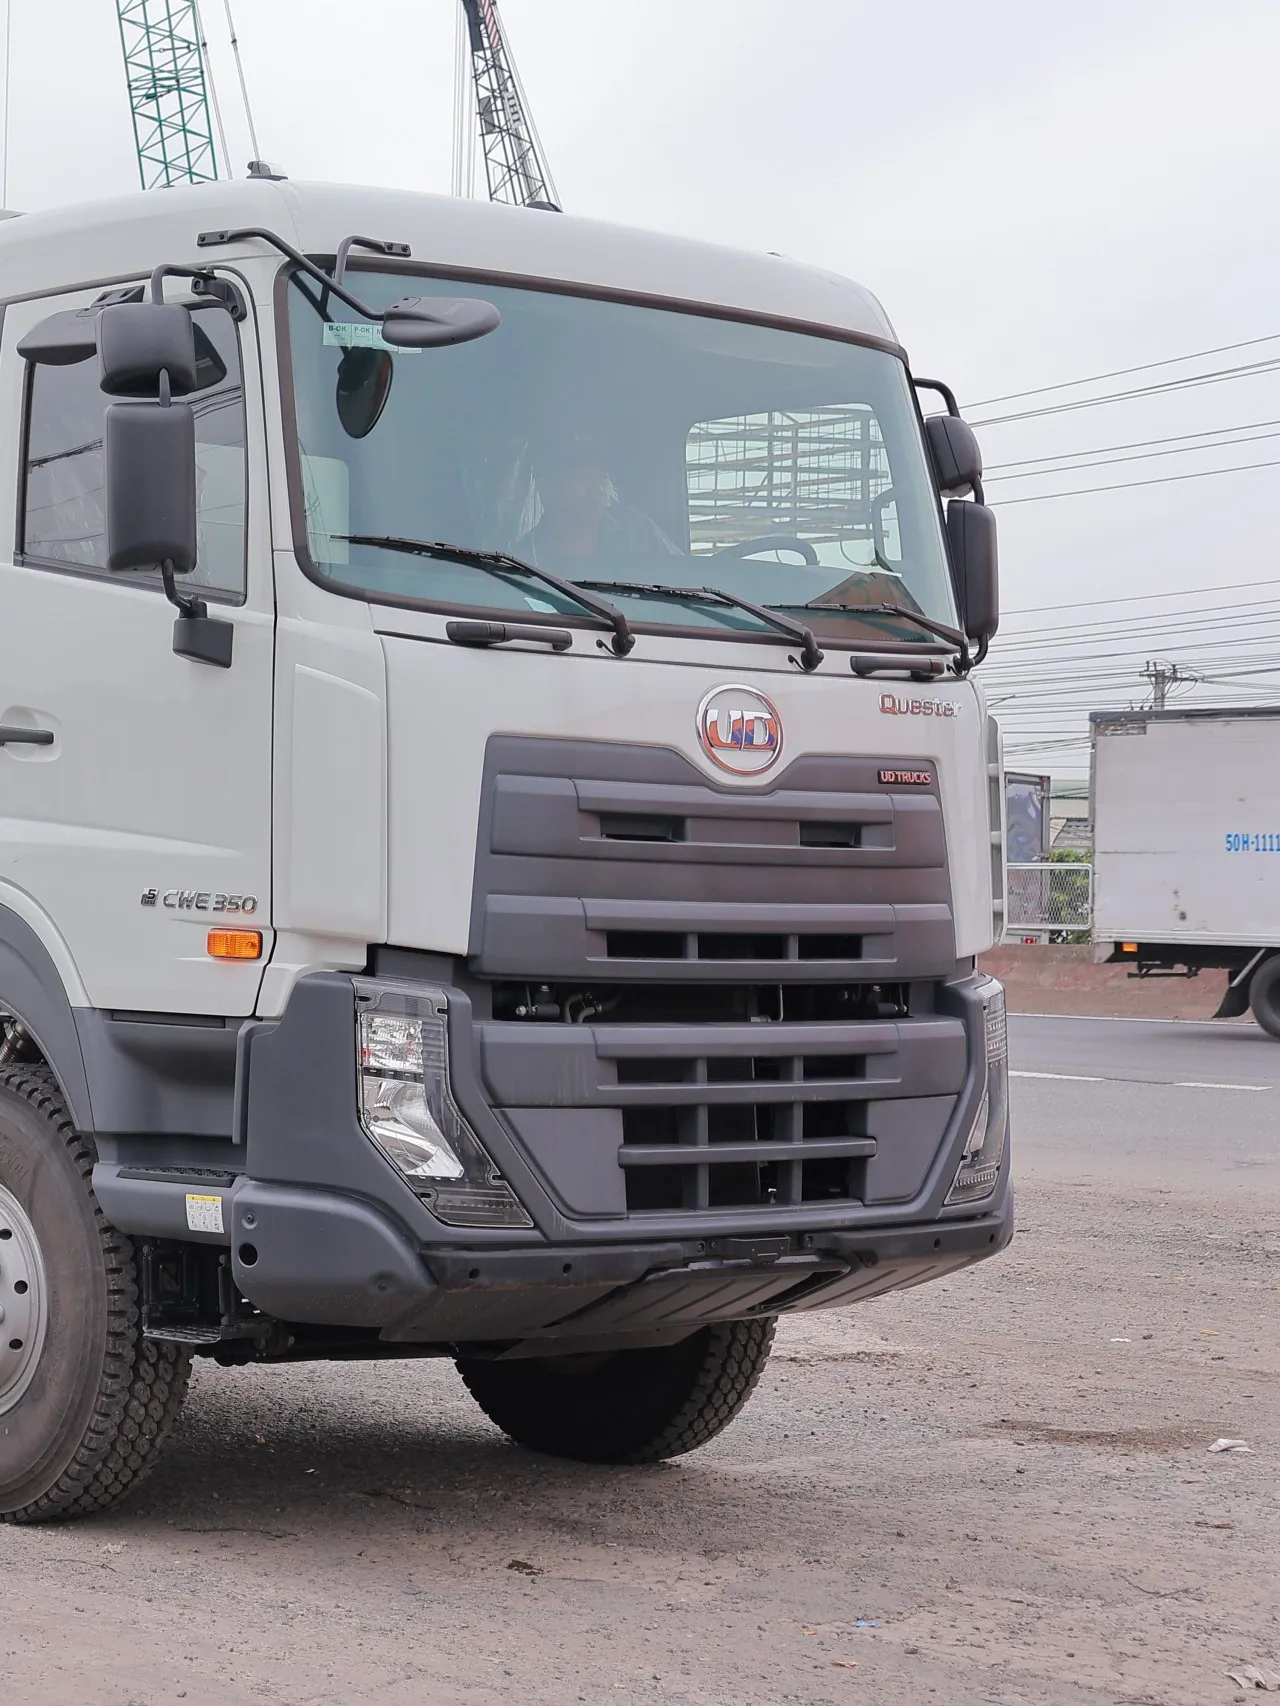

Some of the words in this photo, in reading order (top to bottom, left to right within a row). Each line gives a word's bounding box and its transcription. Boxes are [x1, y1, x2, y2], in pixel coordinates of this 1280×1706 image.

[878, 692, 962, 718] Quester
[706, 708, 779, 751] UD
[881, 771, 896, 782] UD
[896, 771, 932, 784] TRUCKS
[147, 888, 157, 899] 5
[163, 889, 211, 912] CWE
[213, 892, 258, 915] 350
